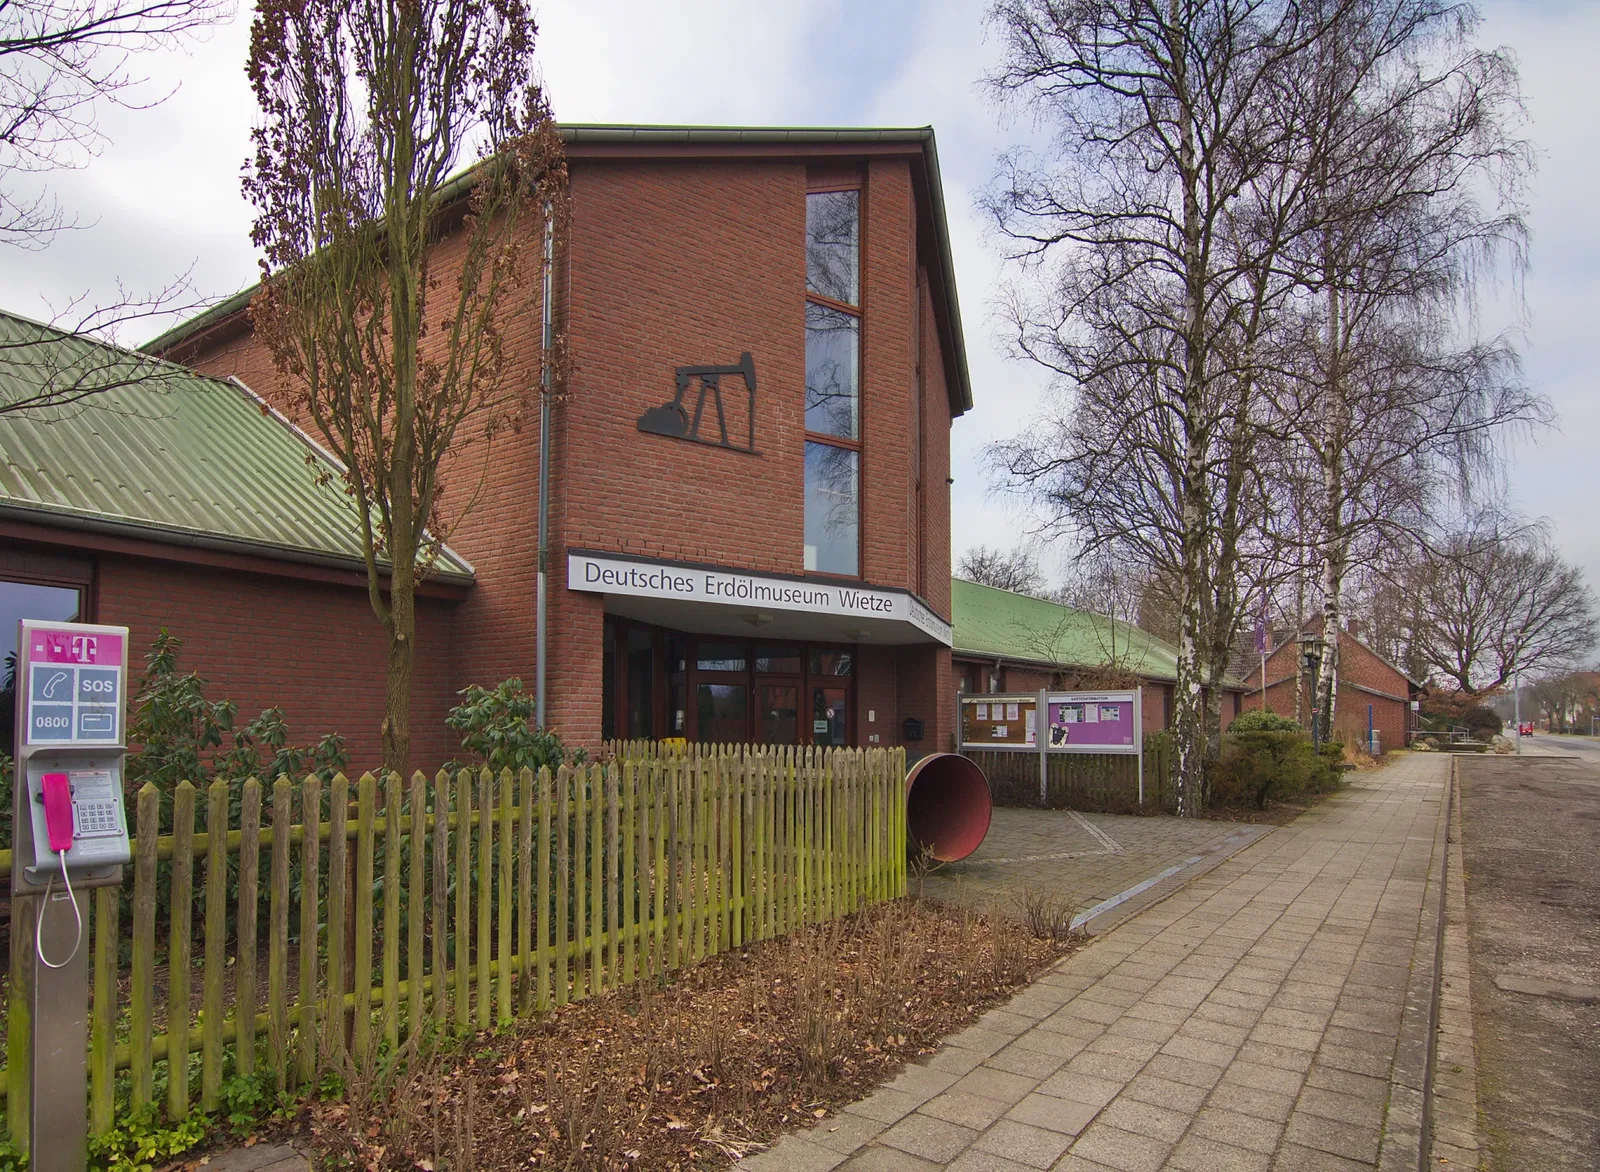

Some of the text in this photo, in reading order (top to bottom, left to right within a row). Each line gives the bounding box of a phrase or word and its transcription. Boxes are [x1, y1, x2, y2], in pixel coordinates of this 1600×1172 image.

[585, 562, 893, 613] Deutsches Erdölmuseum Wietze
[72, 635, 97, 663] T
[82, 680, 114, 693] SOS
[36, 716, 69, 728] 0800
